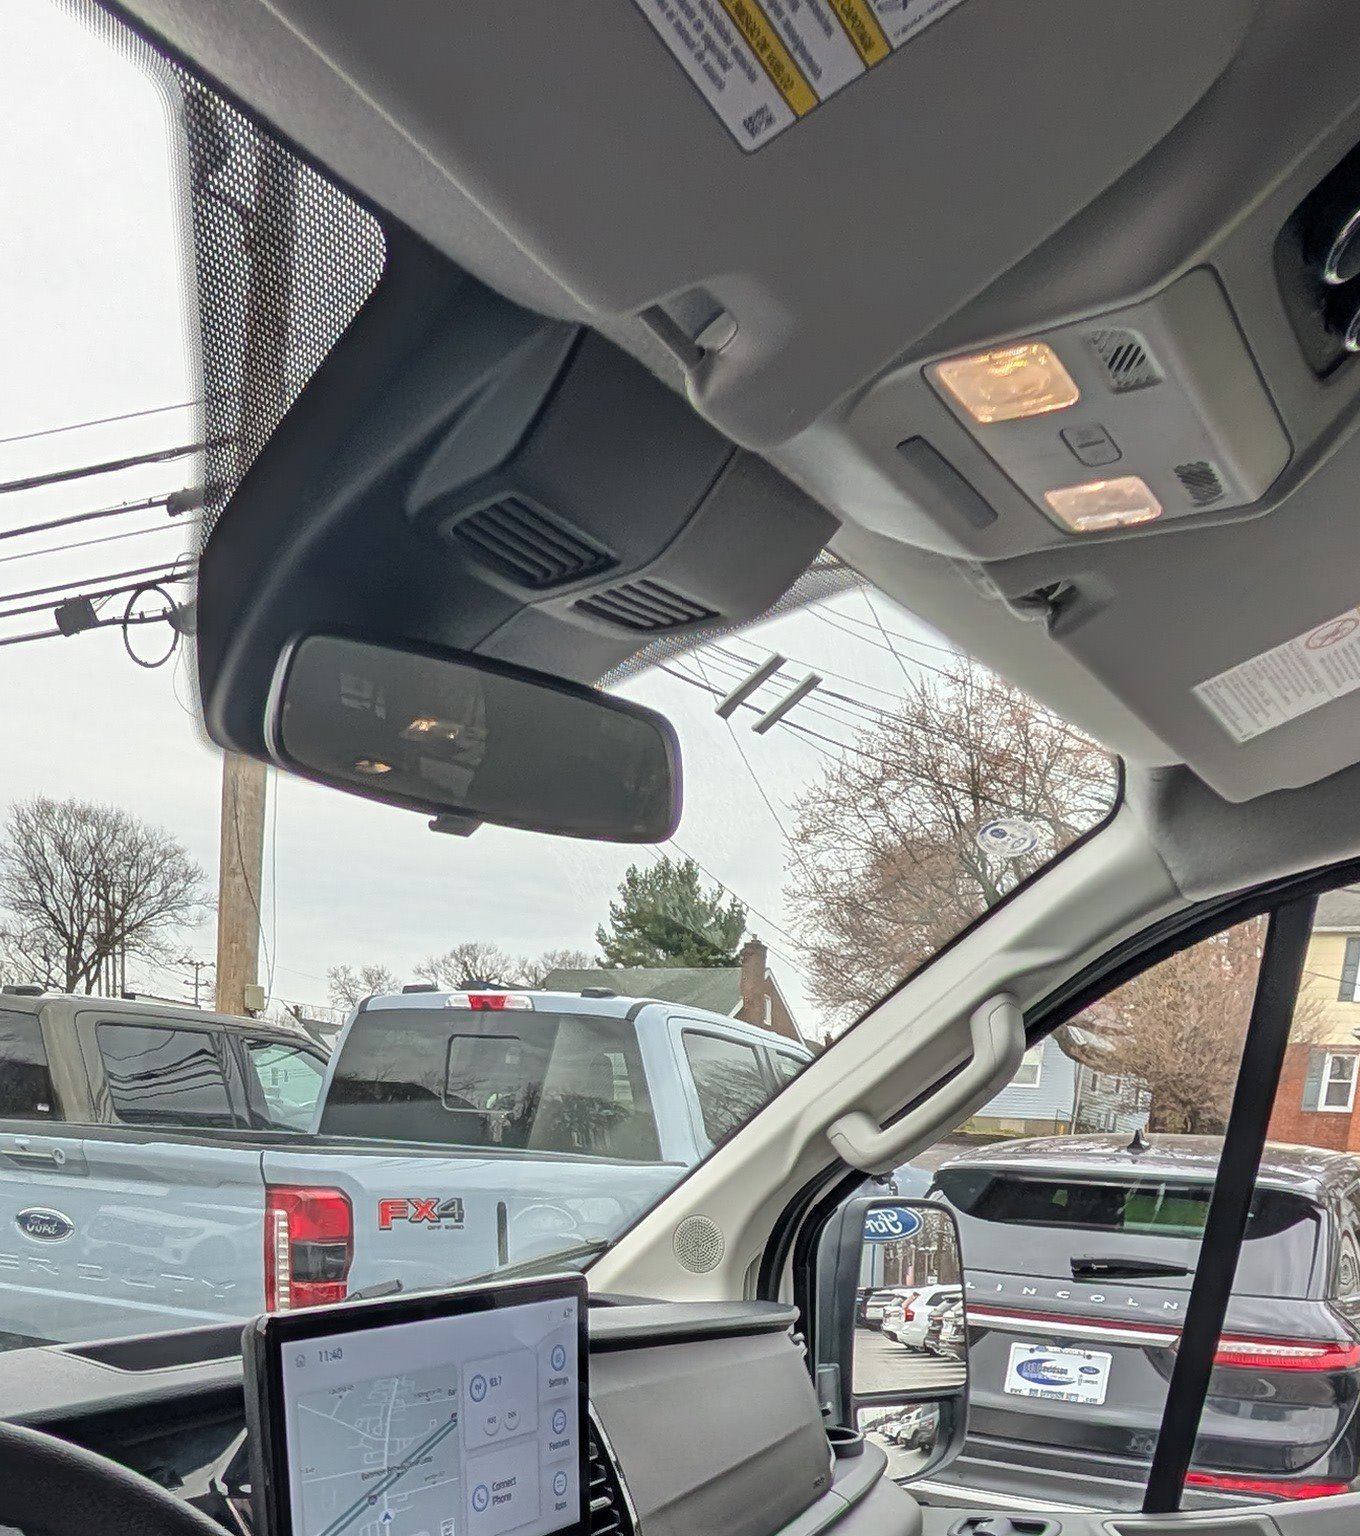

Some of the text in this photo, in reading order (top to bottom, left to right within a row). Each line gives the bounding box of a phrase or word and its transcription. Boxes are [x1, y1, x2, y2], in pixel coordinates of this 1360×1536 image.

[378, 1197, 464, 1231] FX4
[26, 1213, 58, 1235] Ford
[964, 1282, 1180, 1312] LINCOLN
[318, 1347, 344, 1363] 11:40
[491, 1476, 518, 1493] Connect
[492, 1492, 513, 1507] Phone
